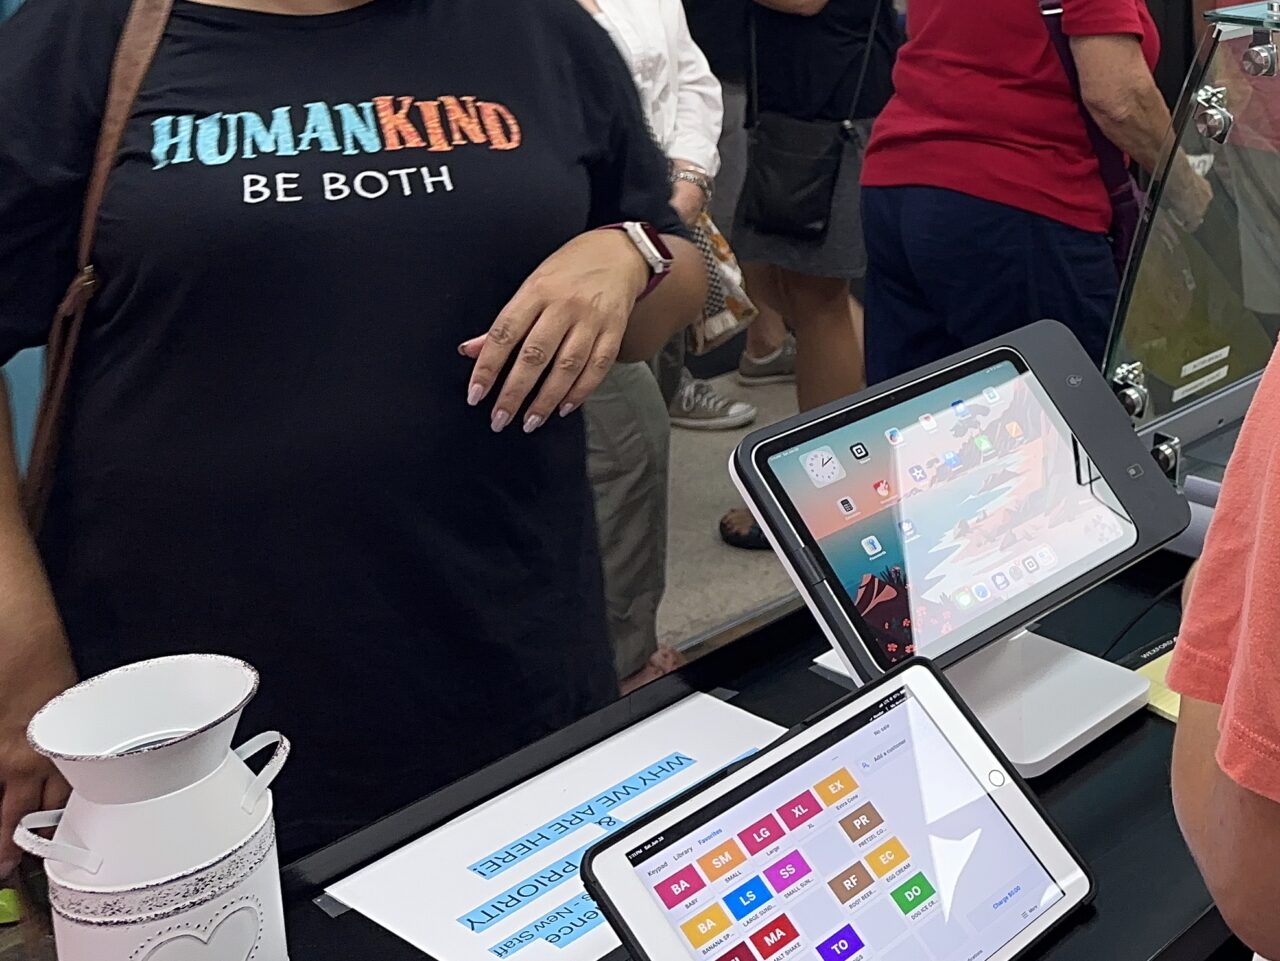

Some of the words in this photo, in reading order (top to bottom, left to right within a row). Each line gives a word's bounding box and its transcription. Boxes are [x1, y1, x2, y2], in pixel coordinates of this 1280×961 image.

[150, 95, 523, 171] HUMANKIND
[242, 172, 303, 203] BE
[322, 165, 454, 201] BOTH
[1140, 639, 1173, 659] WEXFORD
[874, 753, 883, 762] Add
[887, 739, 906, 754] customer
[638, 755, 692, 786] WHY
[828, 780, 845, 794] EX
[596, 784, 639, 808] WE
[835, 800, 847, 811] Extra
[845, 794, 859, 806] Cone
[547, 804, 595, 834] ARE
[791, 804, 809, 818] XL
[594, 816, 616, 827] &
[853, 814, 870, 830] PR
[698, 828, 723, 845] Favorites
[752, 827, 771, 843] LG
[858, 834, 877, 848] PRETZEL
[472, 832, 550, 877] HERE!
[673, 846, 693, 861] Library
[766, 845, 781, 857] Large
[879, 850, 895, 865] EC
[711, 851, 733, 869] SM
[647, 861, 669, 876] Keypad
[724, 869, 742, 884] SMALL
[779, 864, 796, 879] SS
[894, 863, 911, 877] CREAM
[670, 879, 690, 895] BA
[842, 874, 858, 891] RF
[466, 860, 579, 931] PRIORITY
[739, 890, 756, 907] LS
[783, 884, 800, 899] SMALL
[904, 885, 922, 902] DO
[684, 897, 698, 910] BABY
[992, 896, 1009, 910] Charge
[1028, 905, 1038, 913] More
[533, 906, 574, 932] New
[742, 912, 760, 927] LARGE
[910, 910, 922, 921] DOG
[920, 905, 929, 914] ICE
[697, 918, 716, 935] BA
[493, 929, 535, 958] Staff
[763, 927, 786, 948] MA
[701, 937, 724, 955] BANANA
[784, 942, 802, 956] SHAKE
[831, 939, 850, 955] TO
